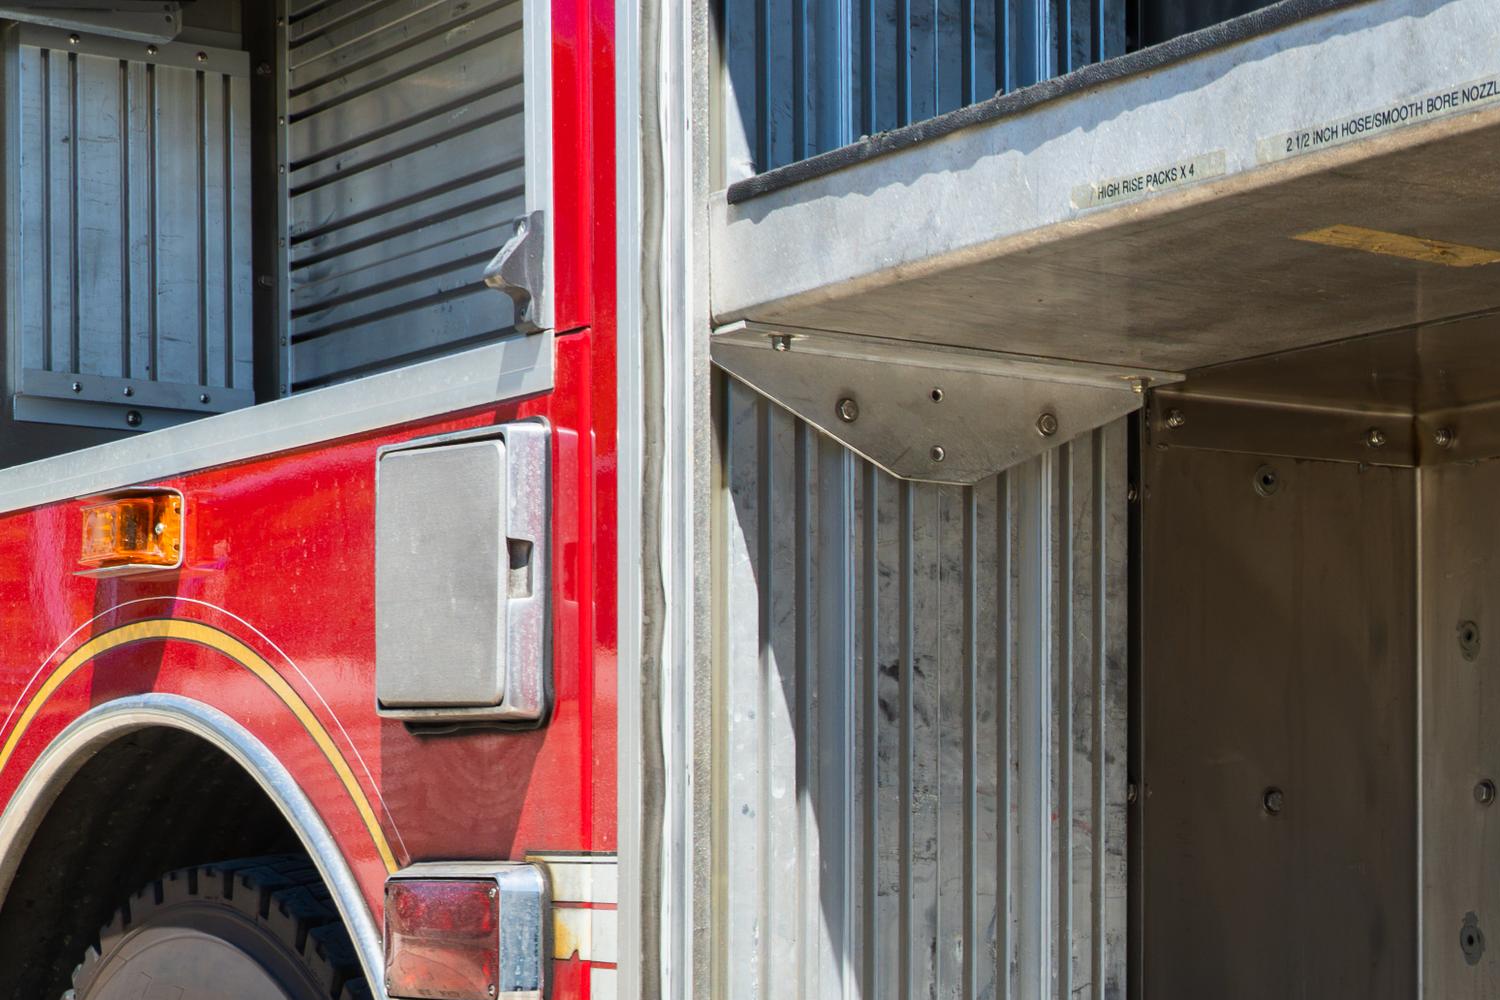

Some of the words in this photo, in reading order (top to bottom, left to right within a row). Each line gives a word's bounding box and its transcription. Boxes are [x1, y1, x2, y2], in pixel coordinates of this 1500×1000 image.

[1286, 137, 1293, 152] 2
[1296, 133, 1310, 149] 1/2
[1313, 125, 1338, 144] INCH
[1342, 101, 1423, 137] HOSE/SMOOTH
[1427, 91, 1459, 113] BORE
[1098, 182, 1120, 199] HIGH
[1122, 176, 1144, 194] RISE
[1146, 167, 1178, 187] PACKS
[1180, 165, 1187, 179] X
[1189, 163, 1195, 177] 4
